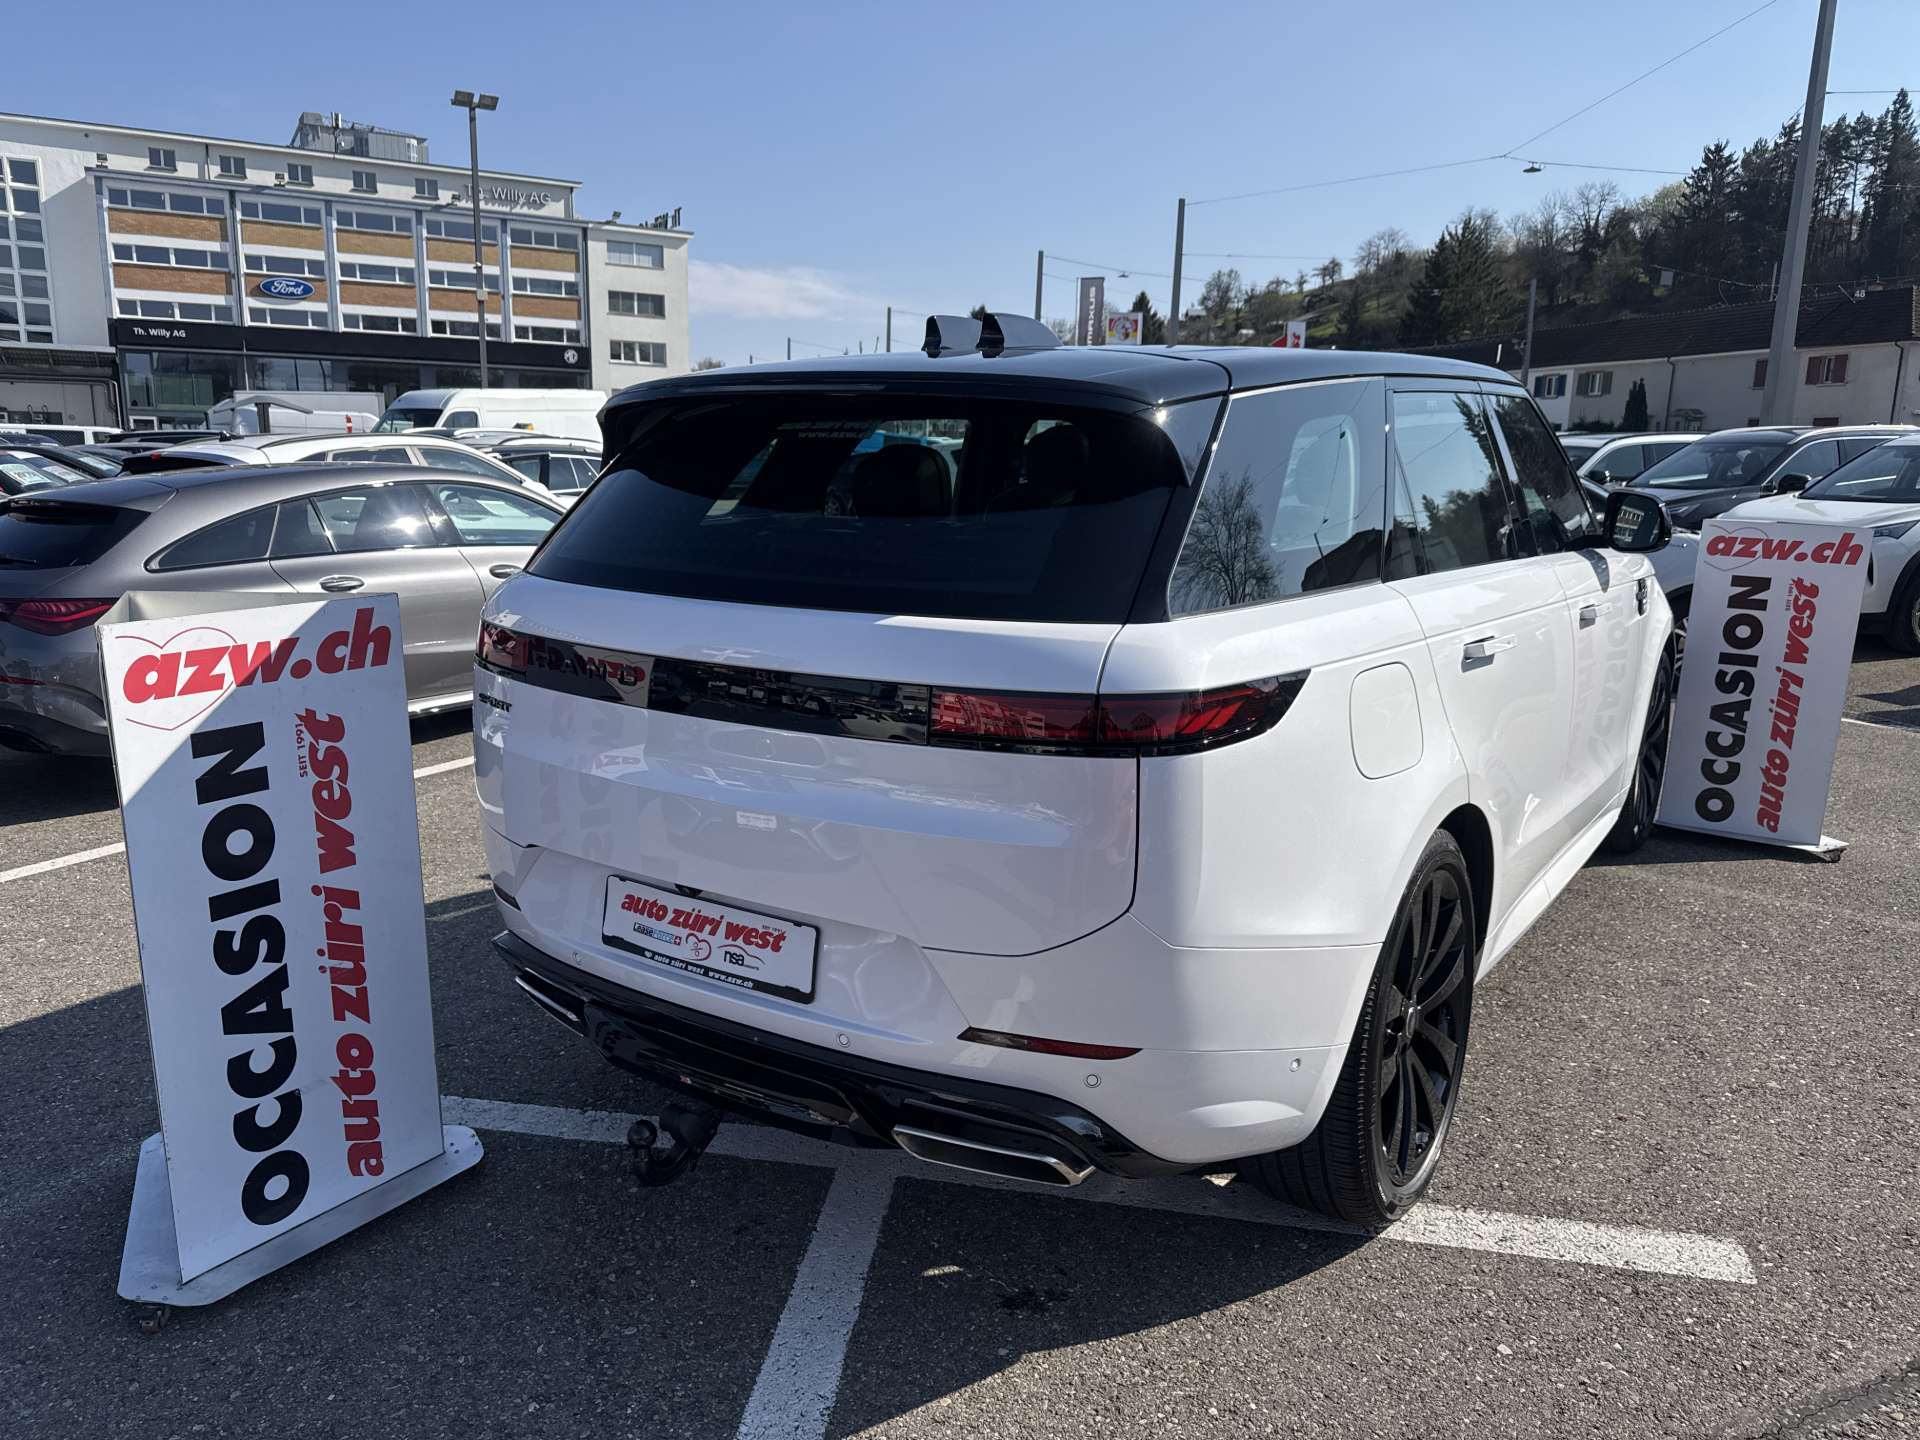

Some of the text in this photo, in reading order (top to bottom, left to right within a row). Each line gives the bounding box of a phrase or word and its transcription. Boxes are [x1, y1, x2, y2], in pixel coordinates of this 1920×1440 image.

[492, 186, 526, 205] Willy
[530, 191, 551, 204] AG
[270, 279, 305, 296] Ford
[132, 327, 187, 339] Th. Willy AG
[1706, 532, 1864, 566] azw.ch
[123, 607, 392, 705] azw.ch
[478, 693, 513, 713] SPORT
[1695, 575, 1772, 823] OCCASION
[1756, 577, 1820, 833] auto züri west
[295, 723, 308, 778] SEIT 1991
[295, 708, 384, 1178] auto züri west
[621, 894, 787, 953] auto züri west
[191, 721, 310, 1226] OCCASION
[653, 954, 670, 965] auto
[687, 965, 705, 975] west
[724, 950, 745, 966] nsa
